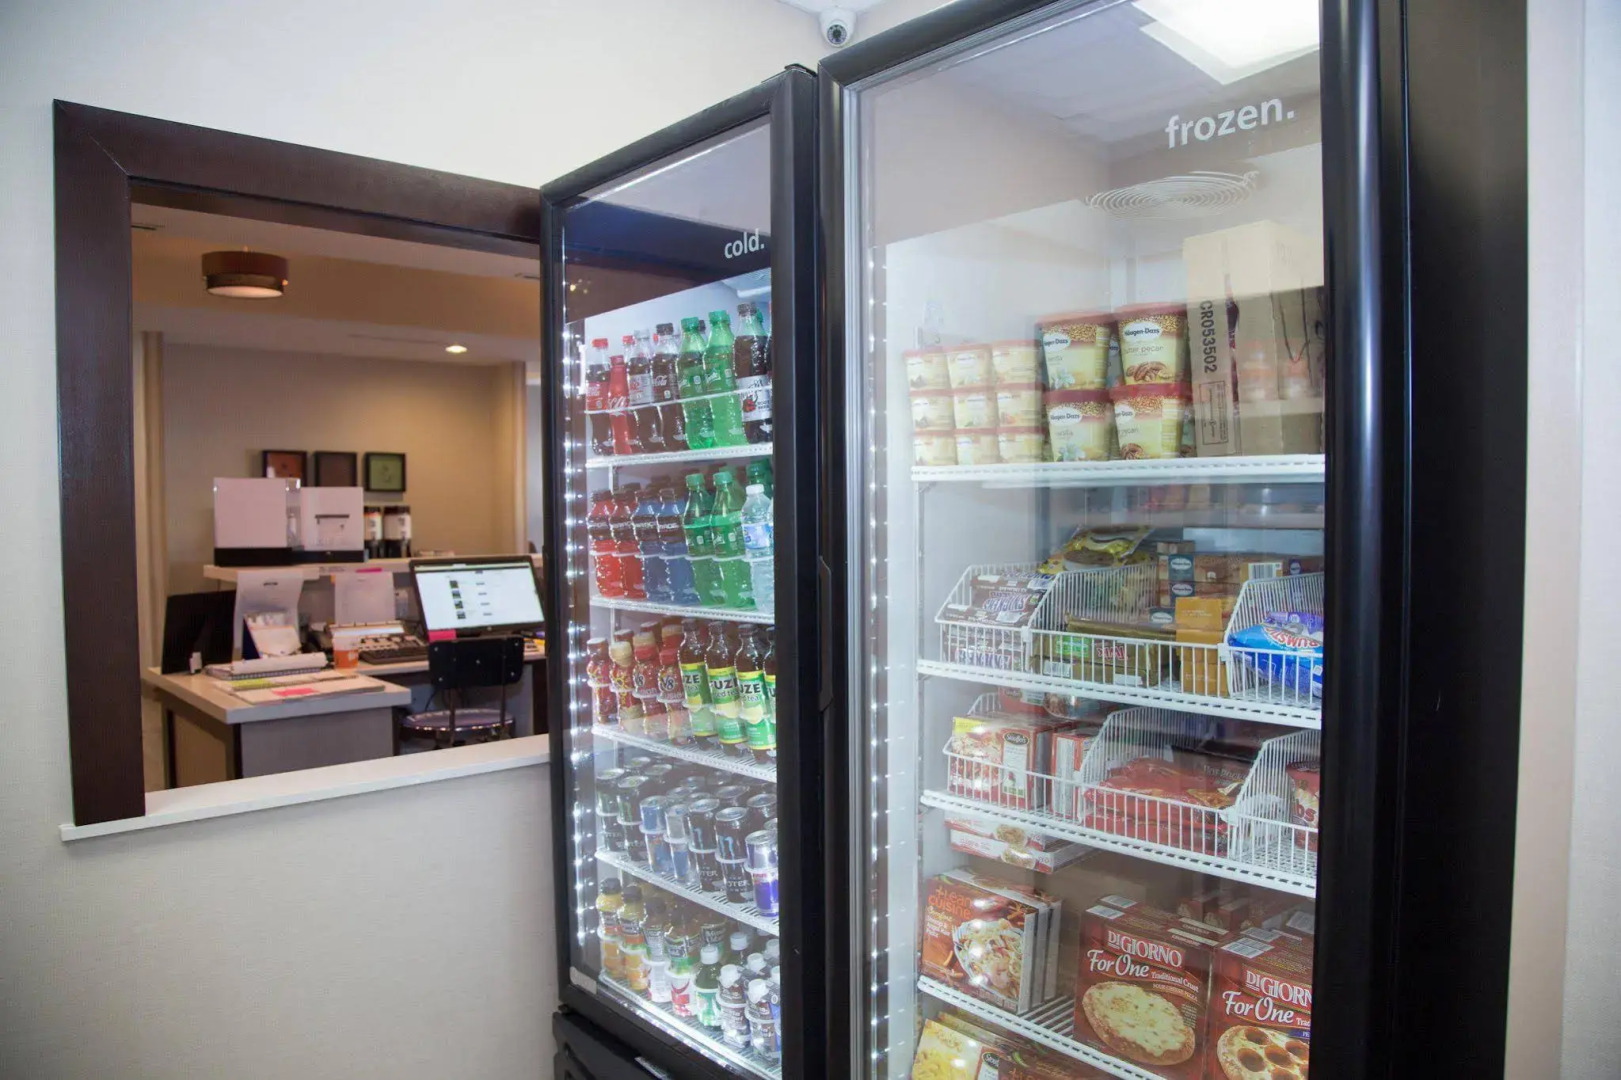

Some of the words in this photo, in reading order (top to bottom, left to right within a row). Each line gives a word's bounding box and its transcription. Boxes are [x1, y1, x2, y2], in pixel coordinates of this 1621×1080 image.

[1165, 98, 1295, 149] frozen.
[724, 227, 765, 259] cold.
[1200, 300, 1218, 374] CR053502
[1087, 949, 1115, 972] For
[1115, 954, 1150, 977] One
[1107, 930, 1182, 968] DIGIORNO
[1222, 990, 1254, 1016] For
[1254, 996, 1294, 1023] One
[1246, 970, 1312, 1007] DIGIORN
